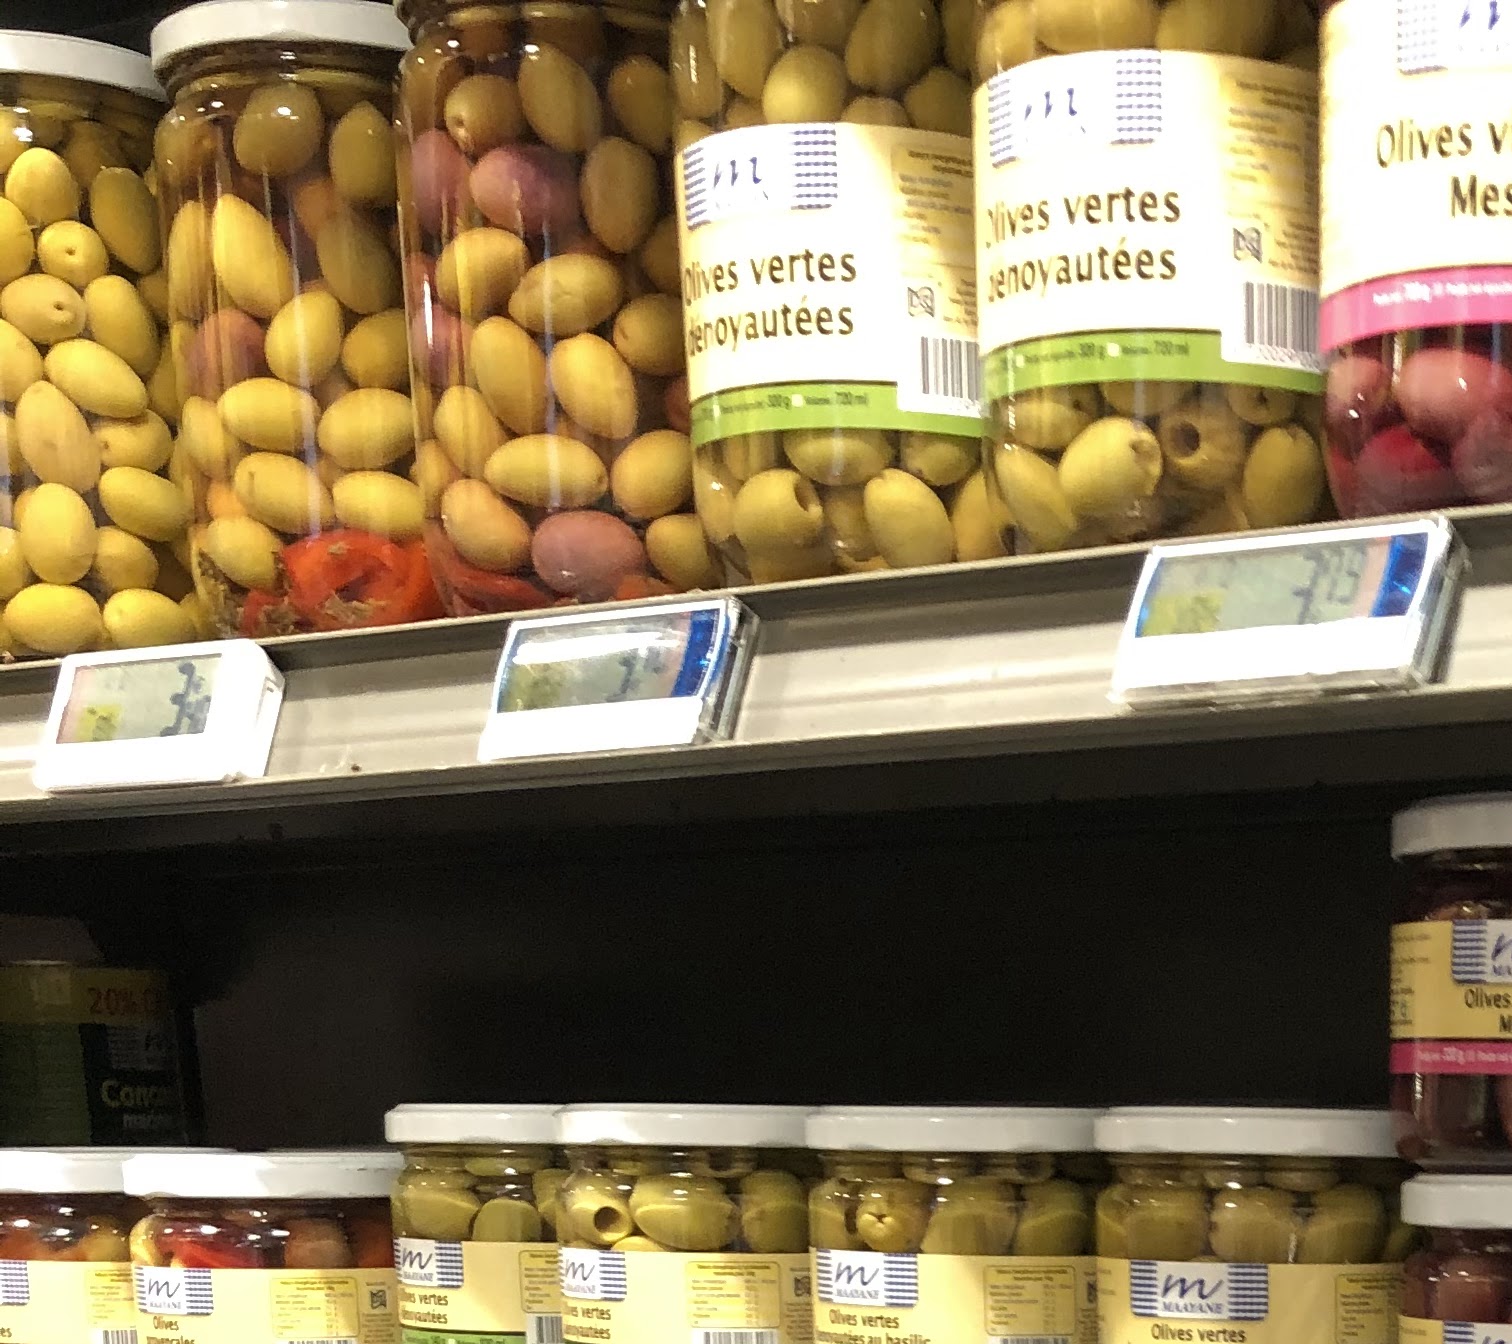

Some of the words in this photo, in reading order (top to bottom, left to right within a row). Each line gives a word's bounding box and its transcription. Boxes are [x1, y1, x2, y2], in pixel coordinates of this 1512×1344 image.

[1063, 187, 1181, 226] vertes
[751, 250, 857, 285] vertes
[1464, 987, 1512, 1011] Olives
[418, 1293, 448, 1306] vertes
[153, 1316, 179, 1332] Olives
[830, 1308, 856, 1329] Olives
[861, 1310, 899, 1329] vertes
[1151, 1322, 1192, 1343] Olives
[1196, 1323, 1247, 1344] vertes
